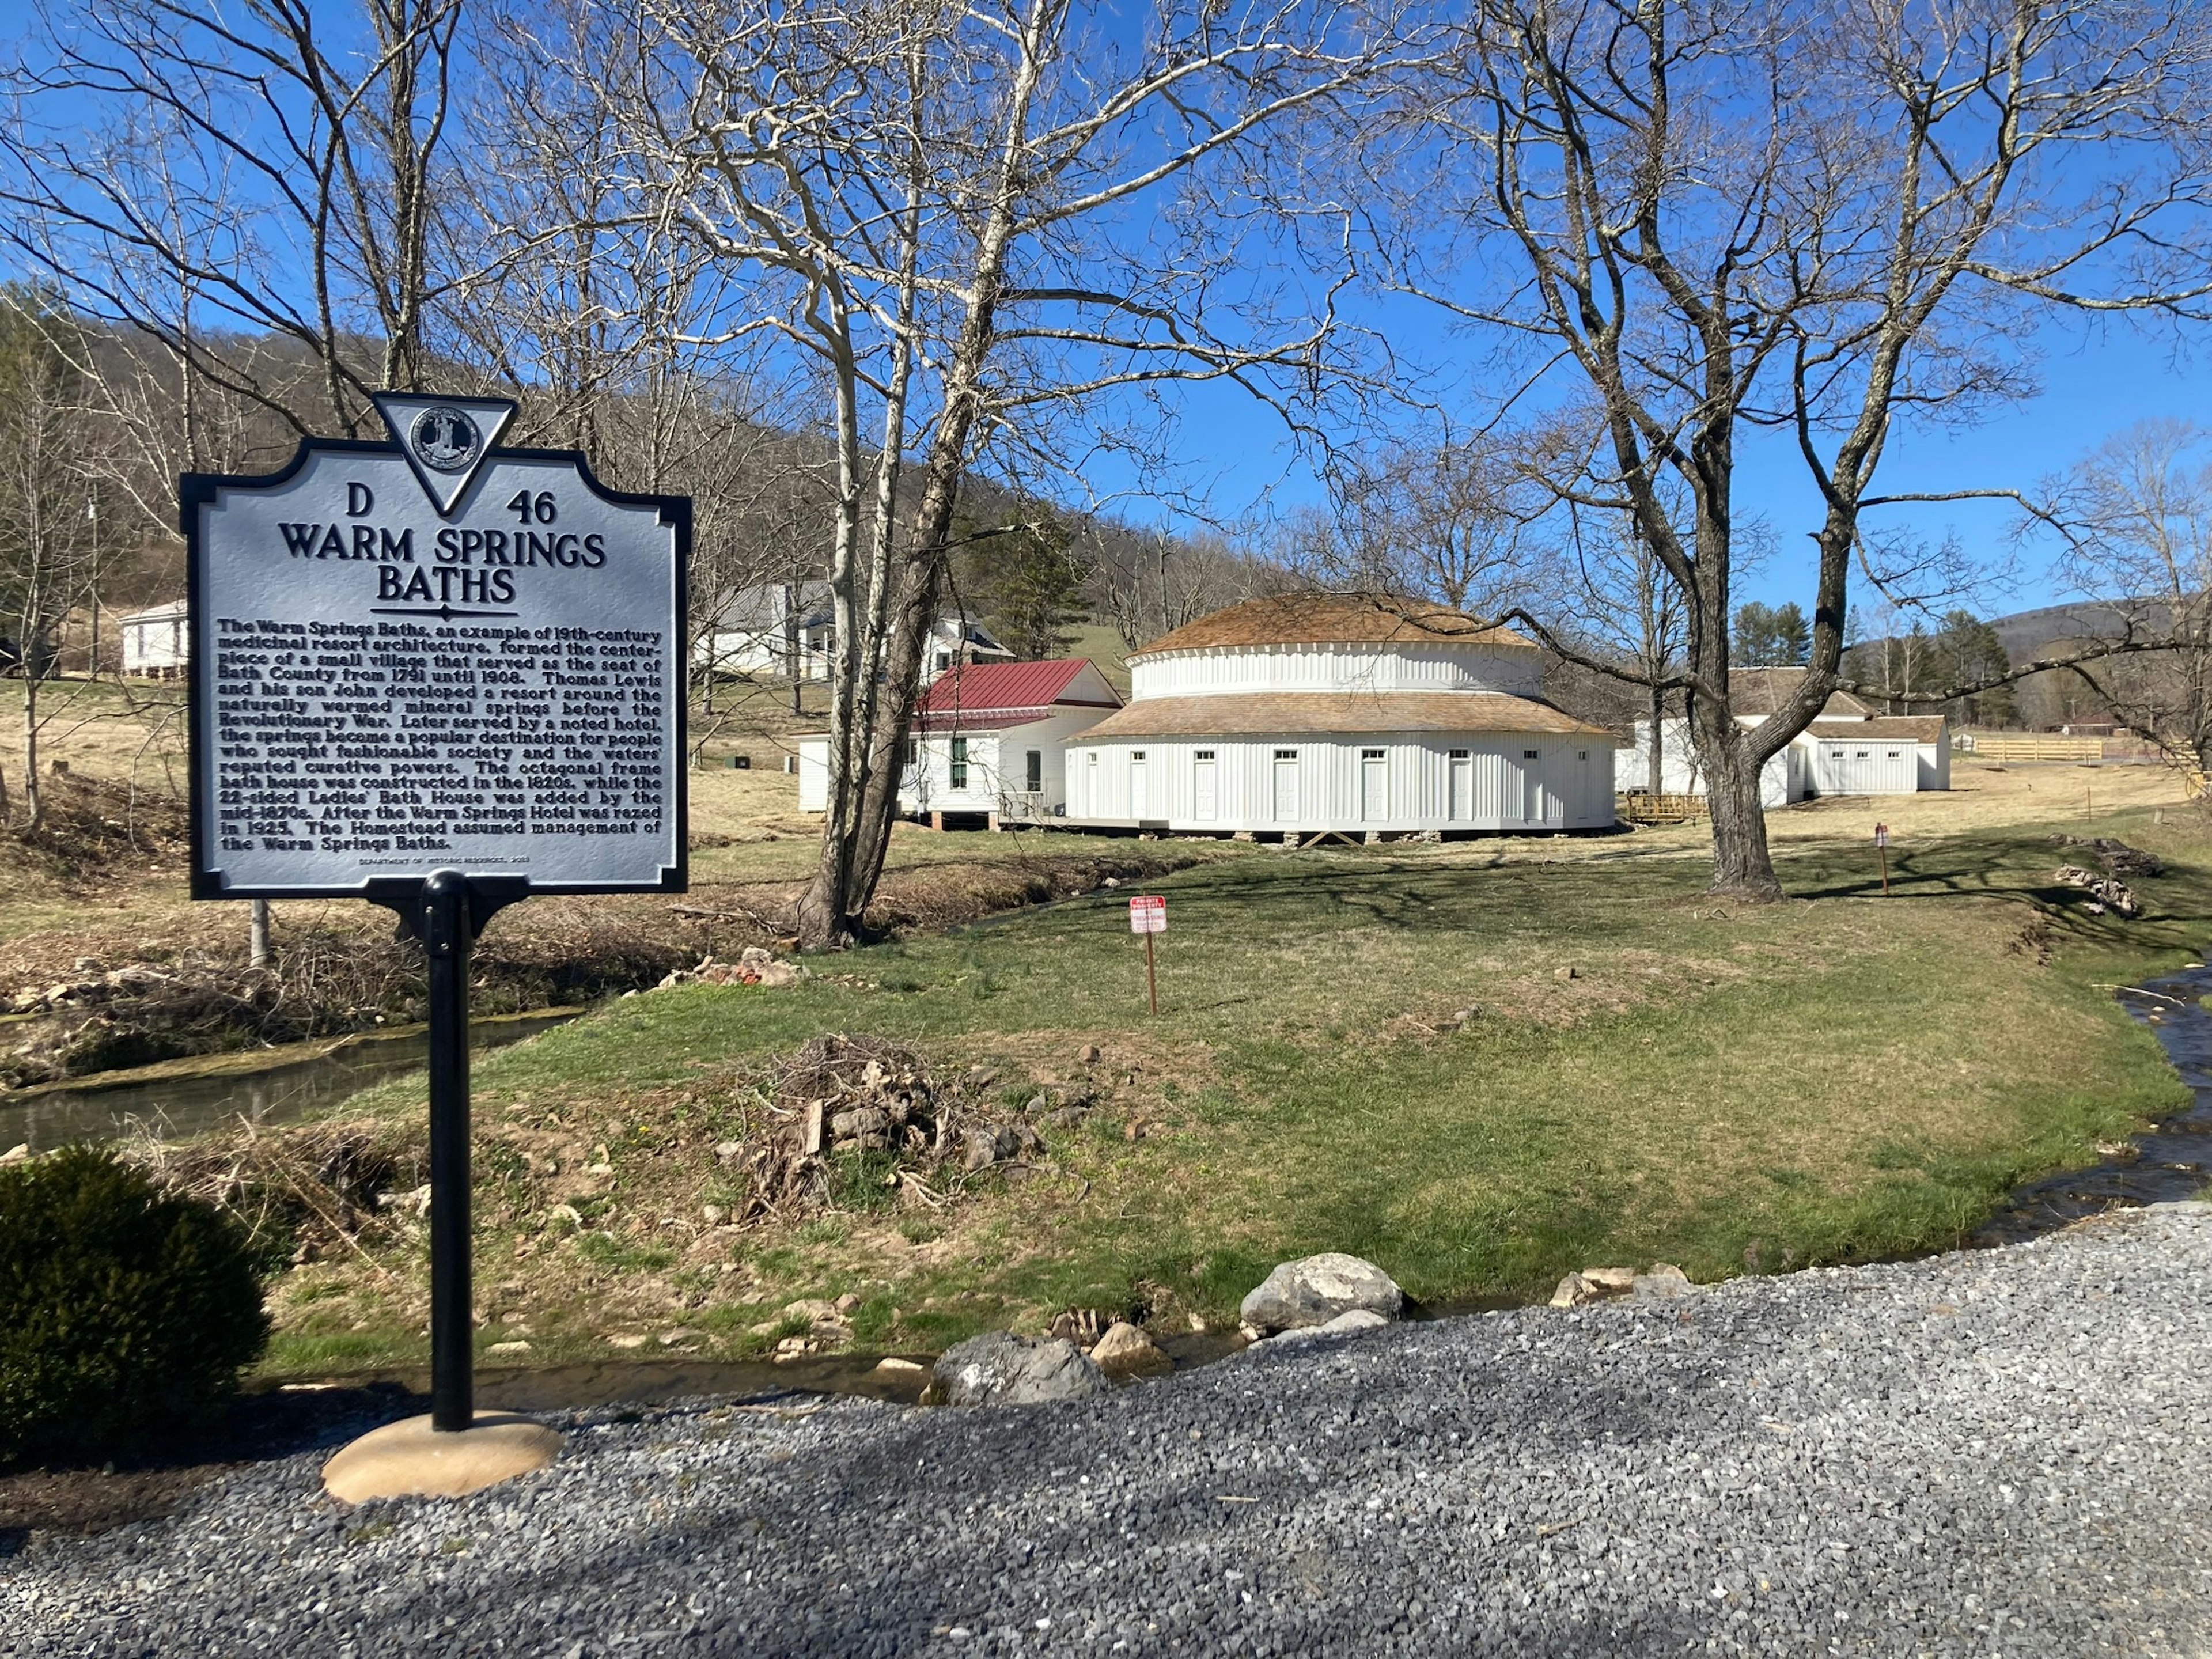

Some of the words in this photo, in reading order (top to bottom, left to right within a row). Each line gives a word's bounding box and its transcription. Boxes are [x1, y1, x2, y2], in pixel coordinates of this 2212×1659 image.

[346, 482, 373, 517] D
[506, 489, 557, 525] 46
[278, 523, 414, 562] WARM
[434, 528, 606, 568] SPRINGS
[377, 565, 515, 603] BATHS
[217, 619, 254, 632] The
[257, 620, 305, 634] Warm
[309, 622, 374, 637] Springs
[436, 627, 457, 638] an
[460, 627, 531, 642] example
[535, 627, 551, 640] of
[555, 627, 661, 645] 19th-century
[217, 637, 308, 650] medicinal
[312, 638, 368, 650] resort
[499, 641, 560, 655] formed
[566, 642, 595, 656] the
[600, 645, 662, 657] center-
[217, 653, 268, 666] piece
[275, 653, 294, 665] of
[300, 656, 310, 665] a
[317, 653, 362, 666] small
[369, 654, 427, 669] village
[434, 655, 471, 668] that
[477, 657, 535, 669] served
[542, 659, 559, 670] as
[566, 657, 596, 671] the
[601, 659, 637, 671] seat
[643, 659, 662, 672] of
[218, 666, 262, 680] Bath
[270, 667, 336, 683] County
[342, 668, 385, 682] from
[392, 669, 426, 683] 1791
[432, 671, 475, 684] until
[543, 672, 607, 686] Thomas
[614, 674, 662, 687] Lewis
[218, 683, 253, 696] and
[261, 683, 289, 696] his
[296, 685, 327, 696] son
[334, 684, 377, 698] John
[385, 684, 477, 700] developed
[484, 689, 494, 699] a
[501, 688, 556, 699] resort
[563, 689, 625, 701] around
[632, 689, 662, 702] the
[218, 699, 309, 715] naturally
[321, 700, 392, 713] warmed
[405, 700, 473, 714] mineral
[486, 702, 550, 717] springs
[562, 703, 620, 715] before
[632, 704, 662, 716] the
[219, 713, 346, 730] Revolutionary
[401, 715, 449, 729] Later
[453, 716, 512, 729] served
[518, 717, 540, 732] by
[546, 719, 555, 729] a
[560, 718, 609, 730] noted
[221, 729, 252, 741] the
[256, 729, 321, 745] springs
[395, 732, 404, 743] a
[408, 730, 475, 745] popular
[479, 730, 575, 744] destination
[579, 732, 605, 745] for
[608, 732, 662, 747] people
[220, 745, 258, 757] who
[268, 745, 328, 760] sought
[336, 745, 438, 759] fashionable
[448, 747, 512, 762] society
[522, 747, 554, 760] and
[565, 748, 593, 760] the
[603, 748, 662, 760] waters'
[219, 760, 296, 774] reputed
[305, 761, 381, 773] curative
[475, 761, 509, 774] The
[520, 762, 603, 777] octagonal
[611, 762, 662, 774] frame
[219, 776, 263, 789] bath
[267, 776, 319, 789] house
[323, 779, 357, 789] was
[361, 777, 468, 789] constructed
[473, 777, 491, 789] in
[494, 777, 524, 789] the
[584, 777, 629, 789] while
[634, 777, 662, 789] the
[219, 790, 299, 804] 22-sided
[309, 791, 370, 804] Ladies'
[380, 791, 422, 804] Bath
[432, 791, 484, 804] House
[494, 793, 524, 804] was
[535, 791, 589, 804] added
[600, 791, 622, 806] by
[632, 791, 662, 804] the
[321, 806, 371, 819] After
[376, 806, 406, 819] the
[410, 806, 457, 819] Warm
[462, 806, 525, 821] Springs
[530, 806, 575, 819] Hotel
[579, 809, 609, 819] was
[614, 806, 662, 819] razed
[220, 822, 238, 835] in
[305, 821, 342, 834] The
[351, 821, 447, 834] Homestead
[453, 821, 525, 834] assumed
[531, 822, 637, 836] management
[644, 821, 662, 833] of
[221, 838, 253, 850] the
[262, 838, 313, 850] Warm
[321, 837, 390, 853] Springs
[396, 837, 452, 850] Baths.
